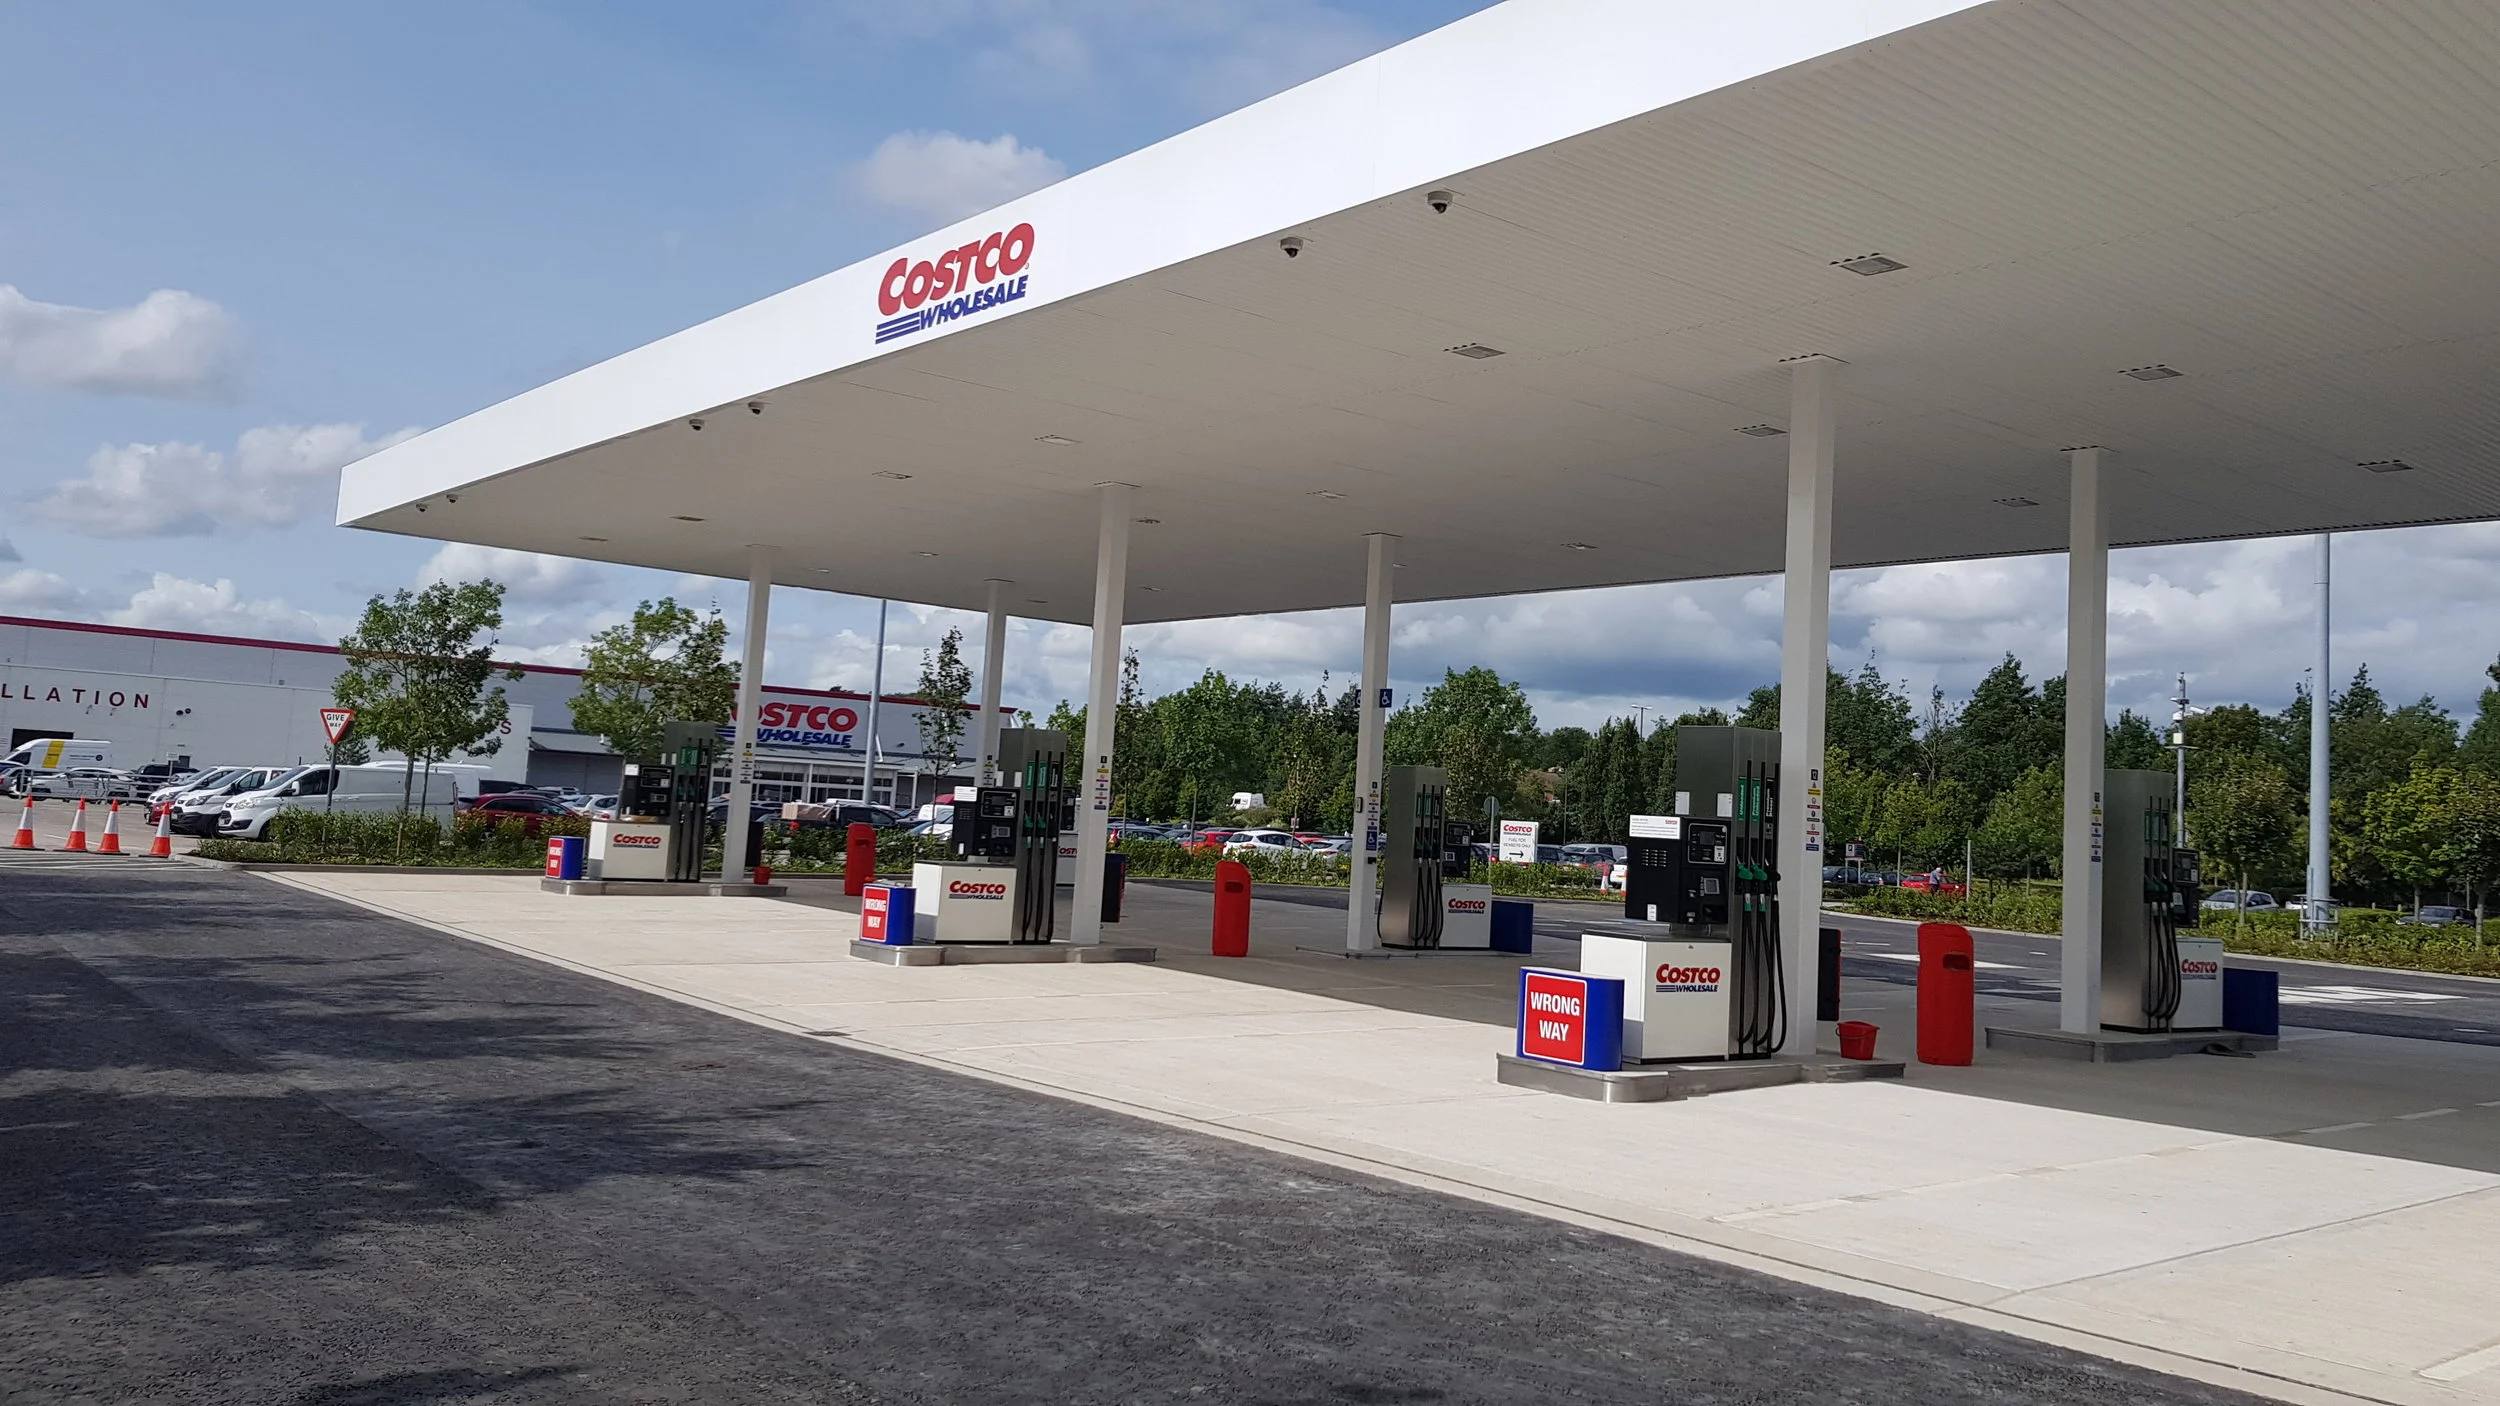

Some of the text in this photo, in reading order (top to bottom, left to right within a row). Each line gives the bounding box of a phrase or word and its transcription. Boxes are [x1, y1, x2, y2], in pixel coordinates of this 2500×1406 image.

[878, 223, 1035, 316] COSTCO
[920, 274, 1029, 330] WHOLESALE
[1, 683, 149, 708] LLATION
[326, 713, 345, 721] GIVE
[1504, 824, 1532, 832] COSTCO
[614, 834, 661, 844] COSTCO
[950, 880, 1006, 894] COSTCO
[865, 898, 887, 912] WRONG
[1448, 898, 1485, 909] COSTCO
[867, 915, 881, 928] WAY
[1656, 963, 1720, 983] COSTCO
[2182, 959, 2217, 973] COSTCO
[1676, 984, 1718, 992] WHOLESALE
[1530, 991, 1580, 1016] WRONG
[1539, 1019, 1570, 1042] WAY
